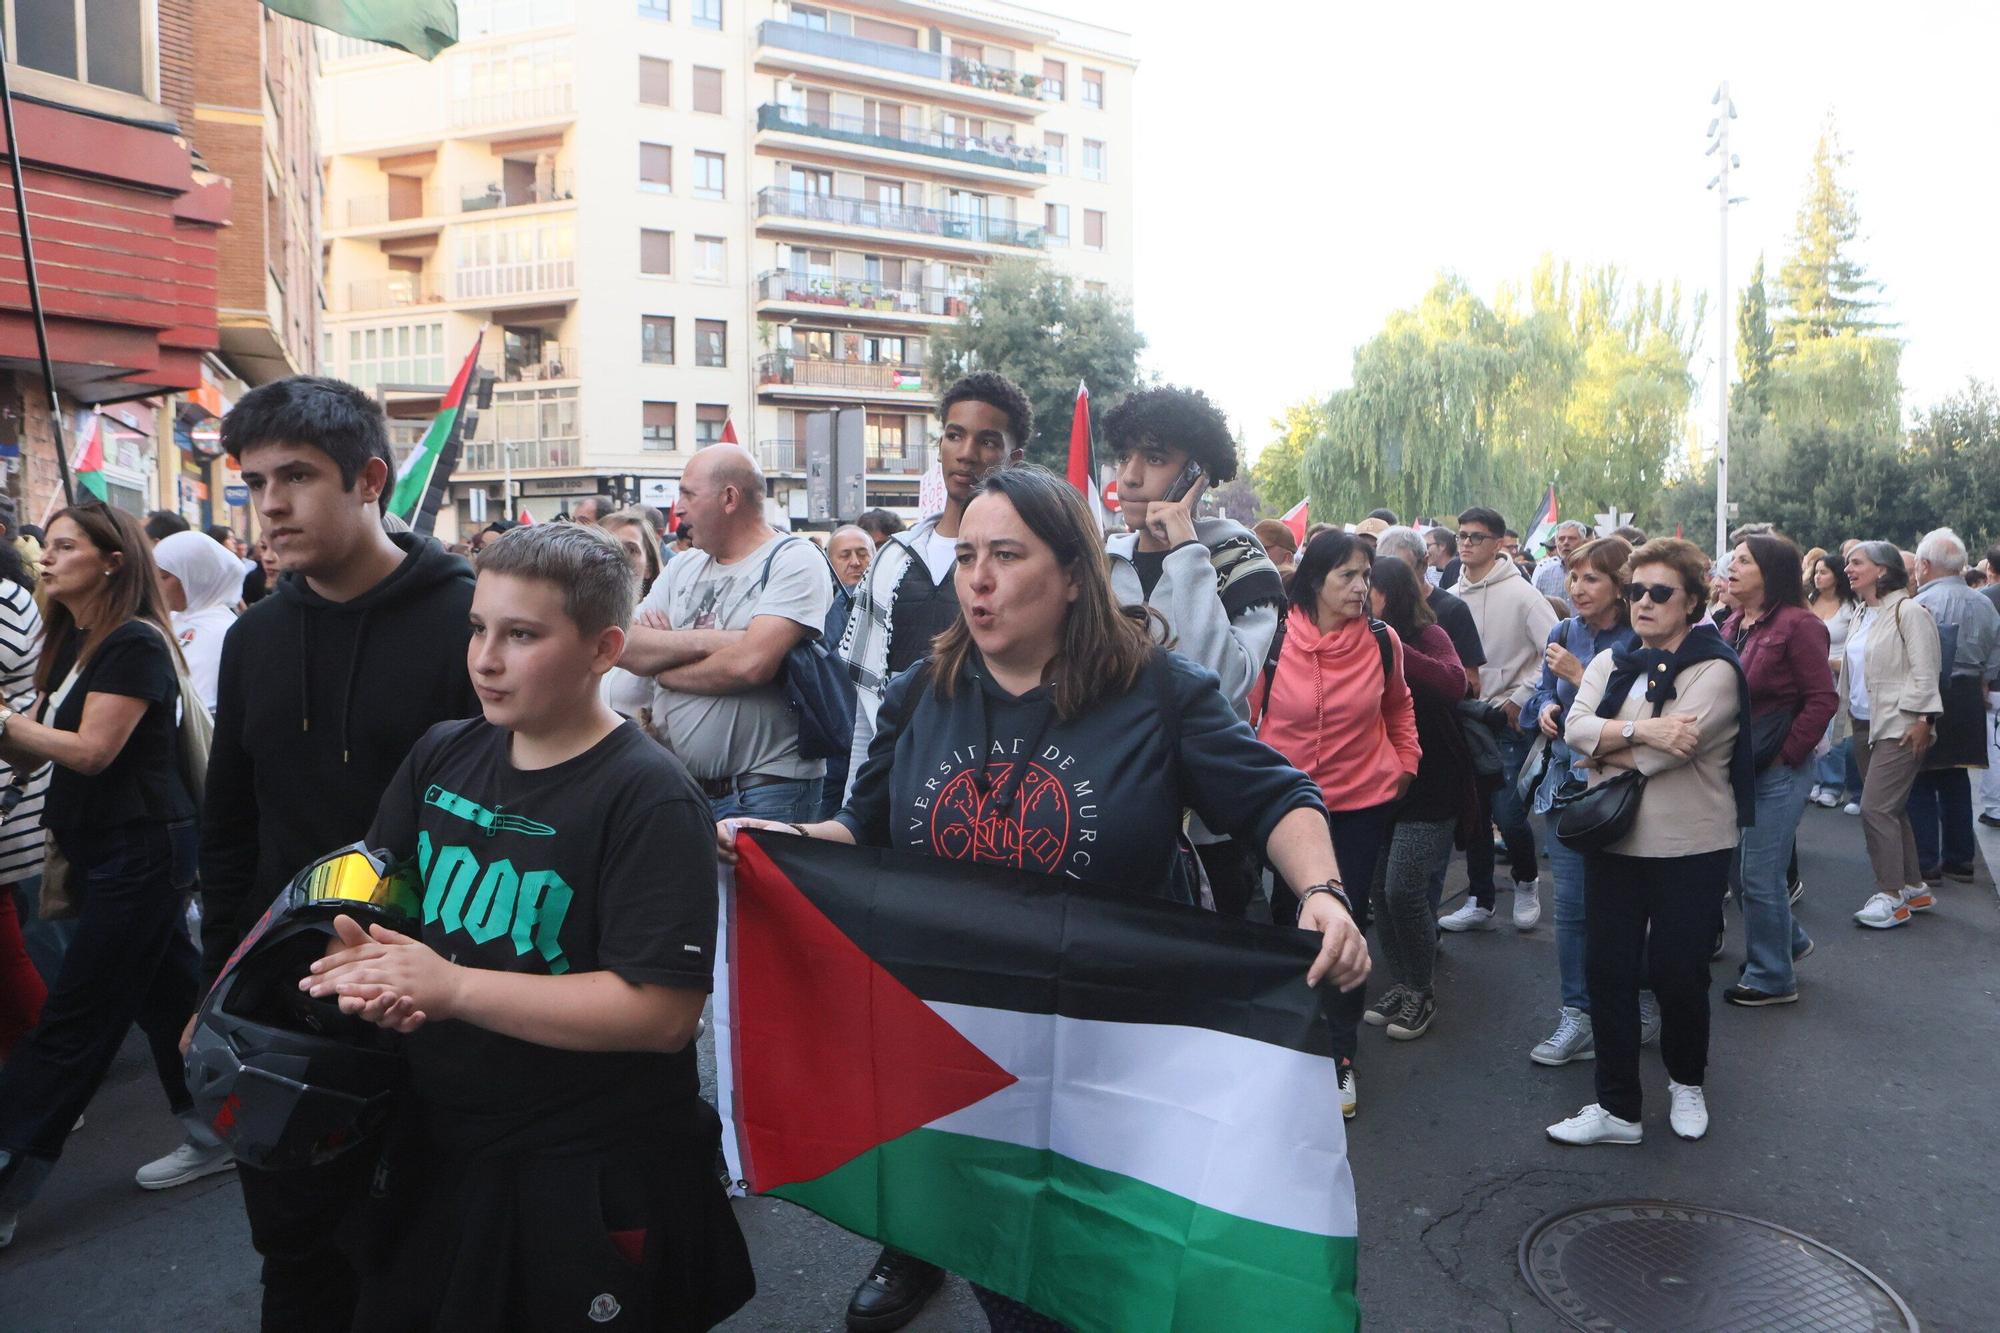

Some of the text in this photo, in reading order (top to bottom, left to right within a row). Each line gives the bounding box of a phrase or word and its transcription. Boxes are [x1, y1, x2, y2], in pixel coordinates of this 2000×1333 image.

[910, 738, 1098, 880] IVERSITAT DE MURCI
[417, 830, 575, 976] NOR
